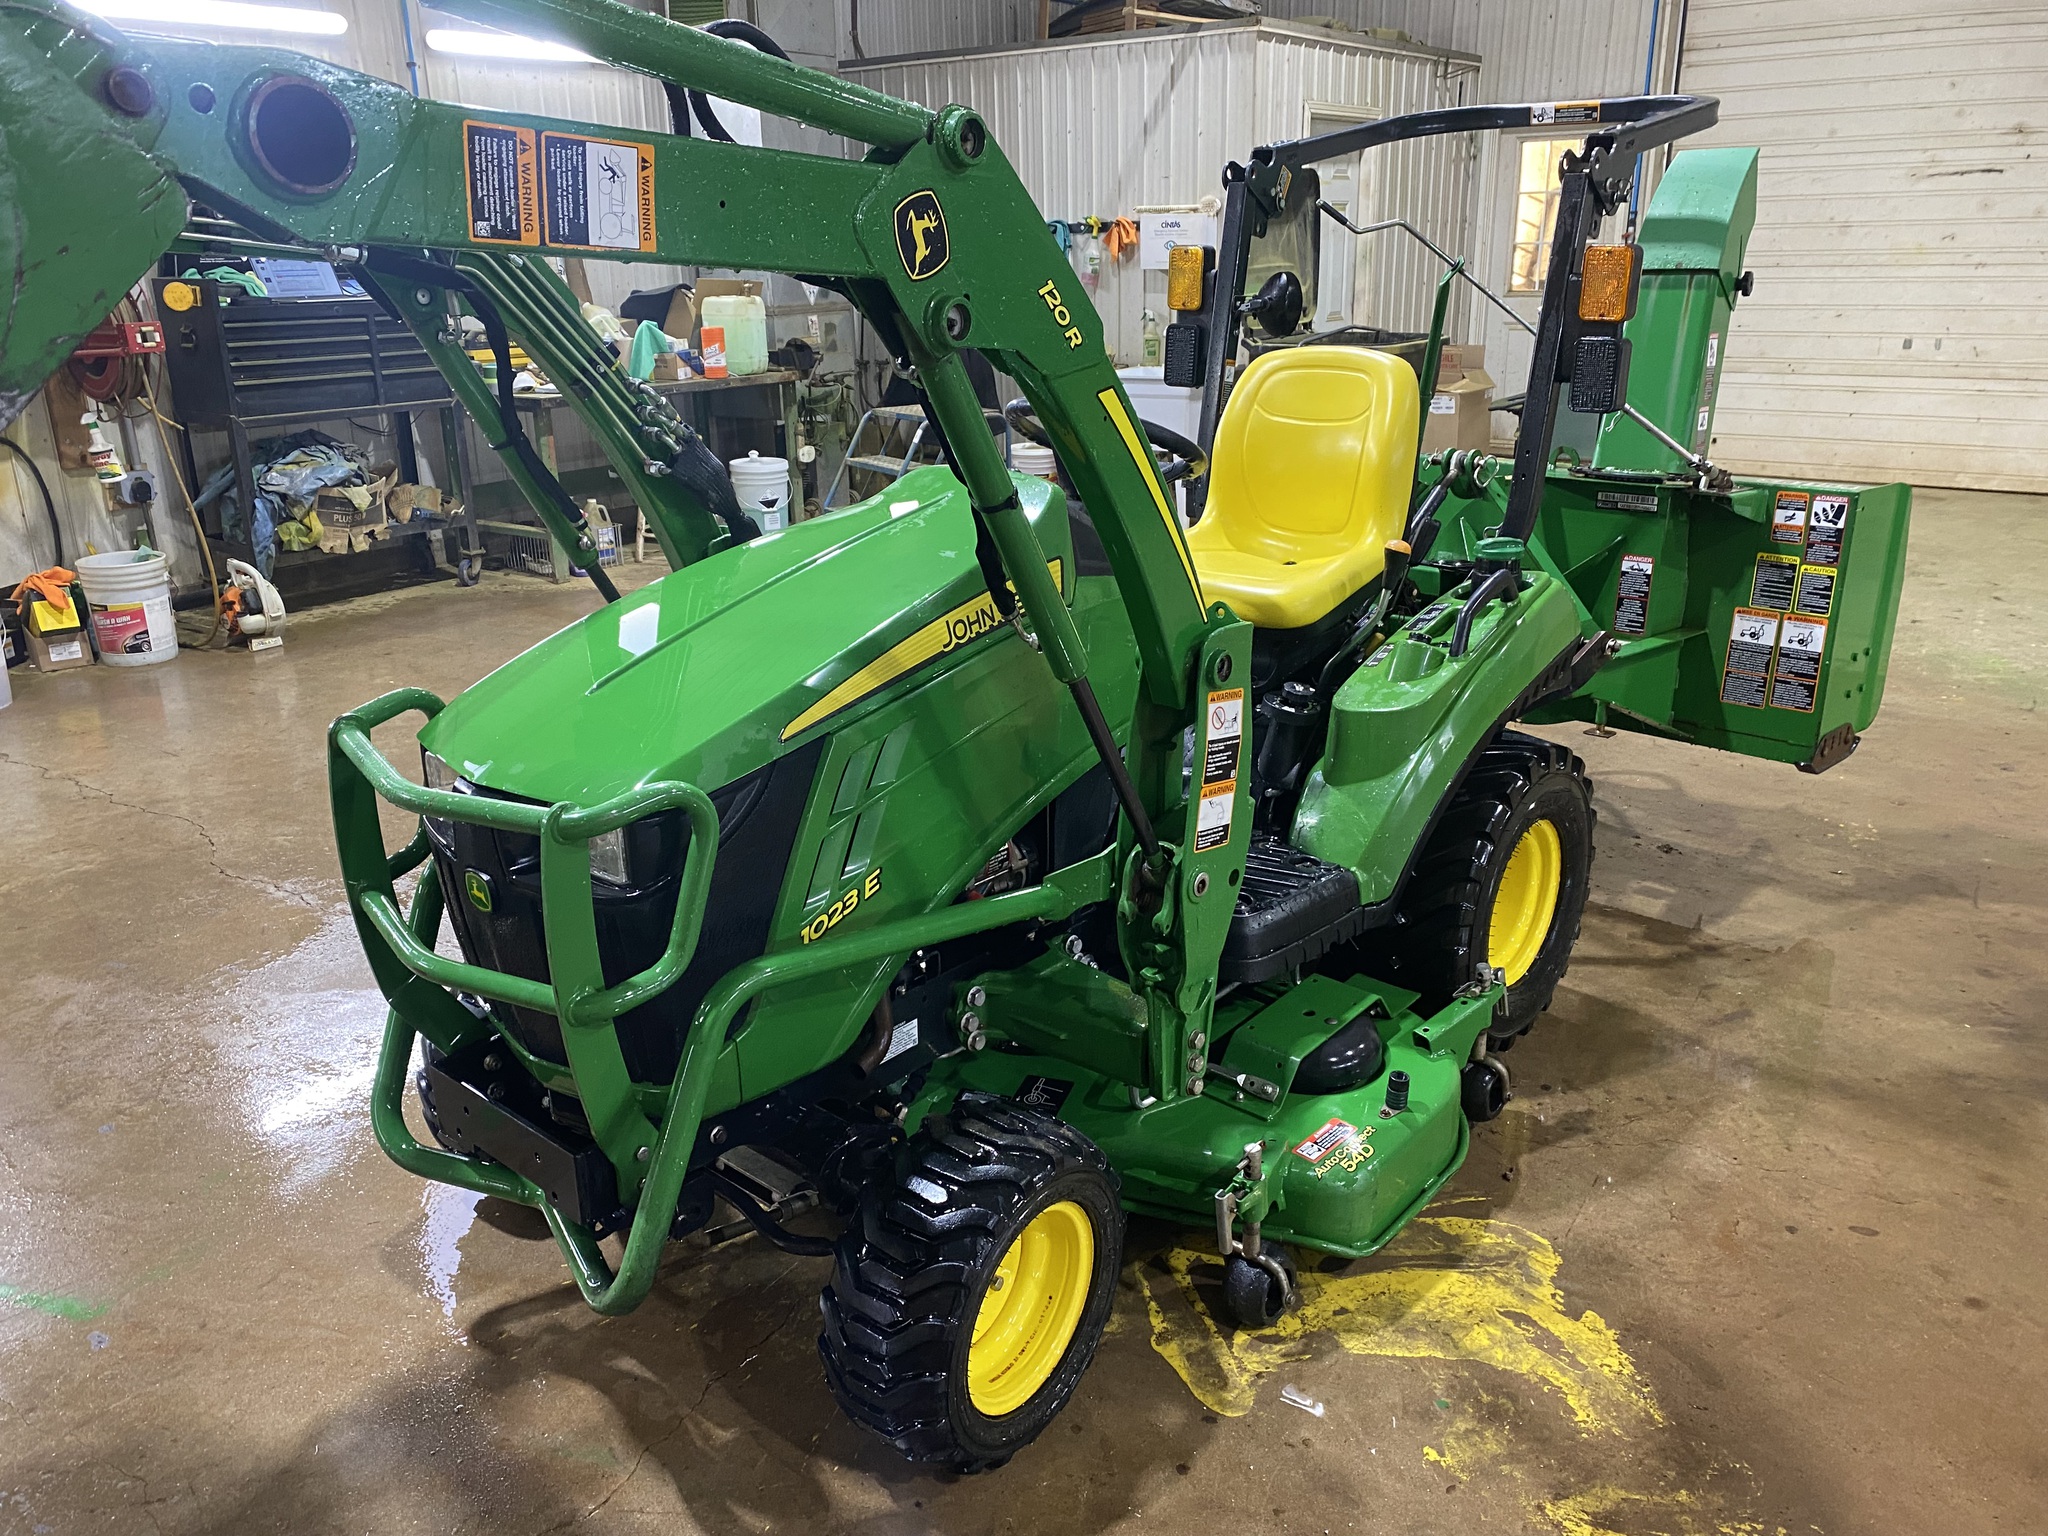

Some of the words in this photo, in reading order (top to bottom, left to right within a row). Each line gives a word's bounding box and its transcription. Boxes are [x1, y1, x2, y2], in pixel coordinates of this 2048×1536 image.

[508, 141, 513, 150] DO
[567, 150, 572, 158] Do
[521, 162, 533, 233] WARNING
[642, 176, 652, 241] WARNING
[1037, 278, 1071, 327] 120
[1063, 326, 1083, 350] R
[91, 452, 110, 462] pray
[334, 514, 352, 522] PLUS
[1766, 555, 1797, 563] ATTENTION
[942, 604, 996, 650] JOHN
[1216, 690, 1242, 701] WARNING
[1209, 784, 1234, 796] WARNING
[800, 888, 860, 945] 1023
[864, 866, 882, 901] E
[1314, 1126, 1376, 1180] AutoCoect
[1340, 1144, 1376, 1172] 54D
